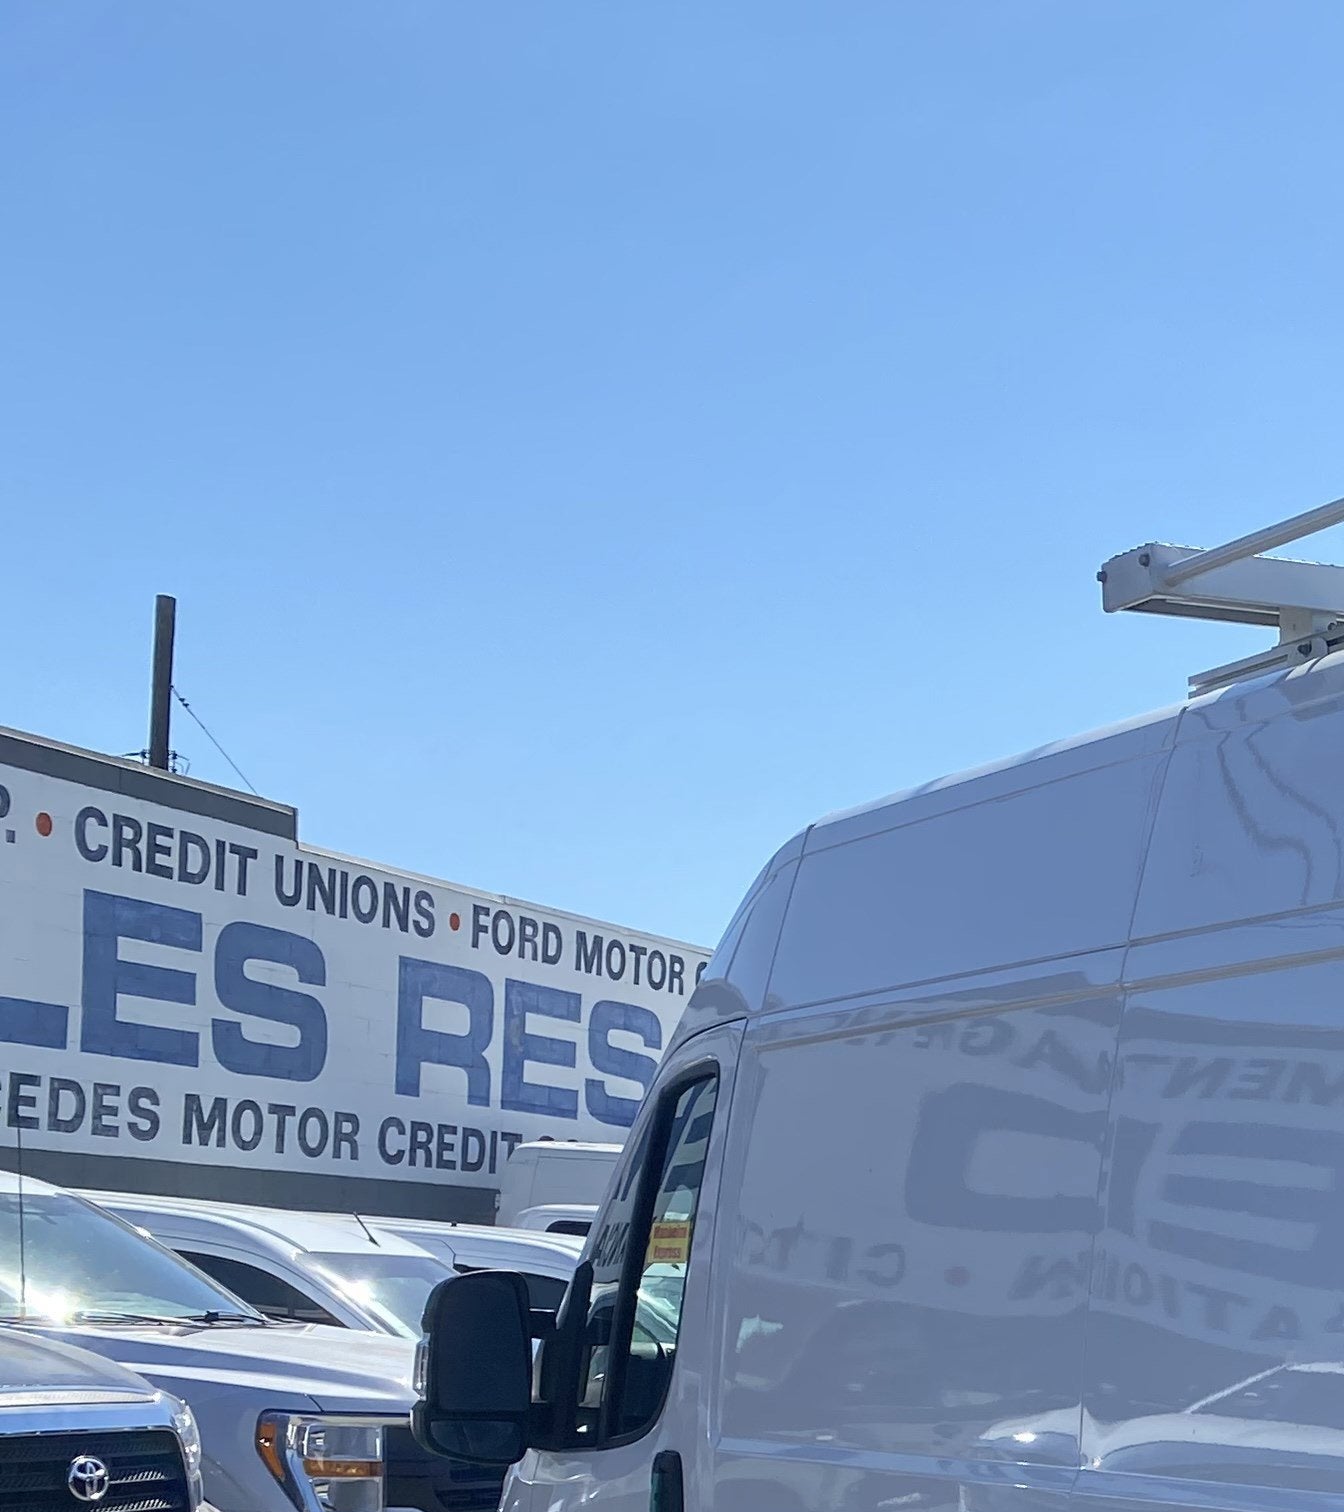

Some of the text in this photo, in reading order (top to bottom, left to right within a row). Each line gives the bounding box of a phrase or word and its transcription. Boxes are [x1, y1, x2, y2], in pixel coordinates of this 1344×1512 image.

[74, 806, 259, 896] CREDIT
[274, 854, 436, 938] UNIONS
[471, 904, 563, 966] FORD
[574, 930, 685, 996] MOTOR
[0, 1071, 523, 1174] EDES MOTOR CREDIT
